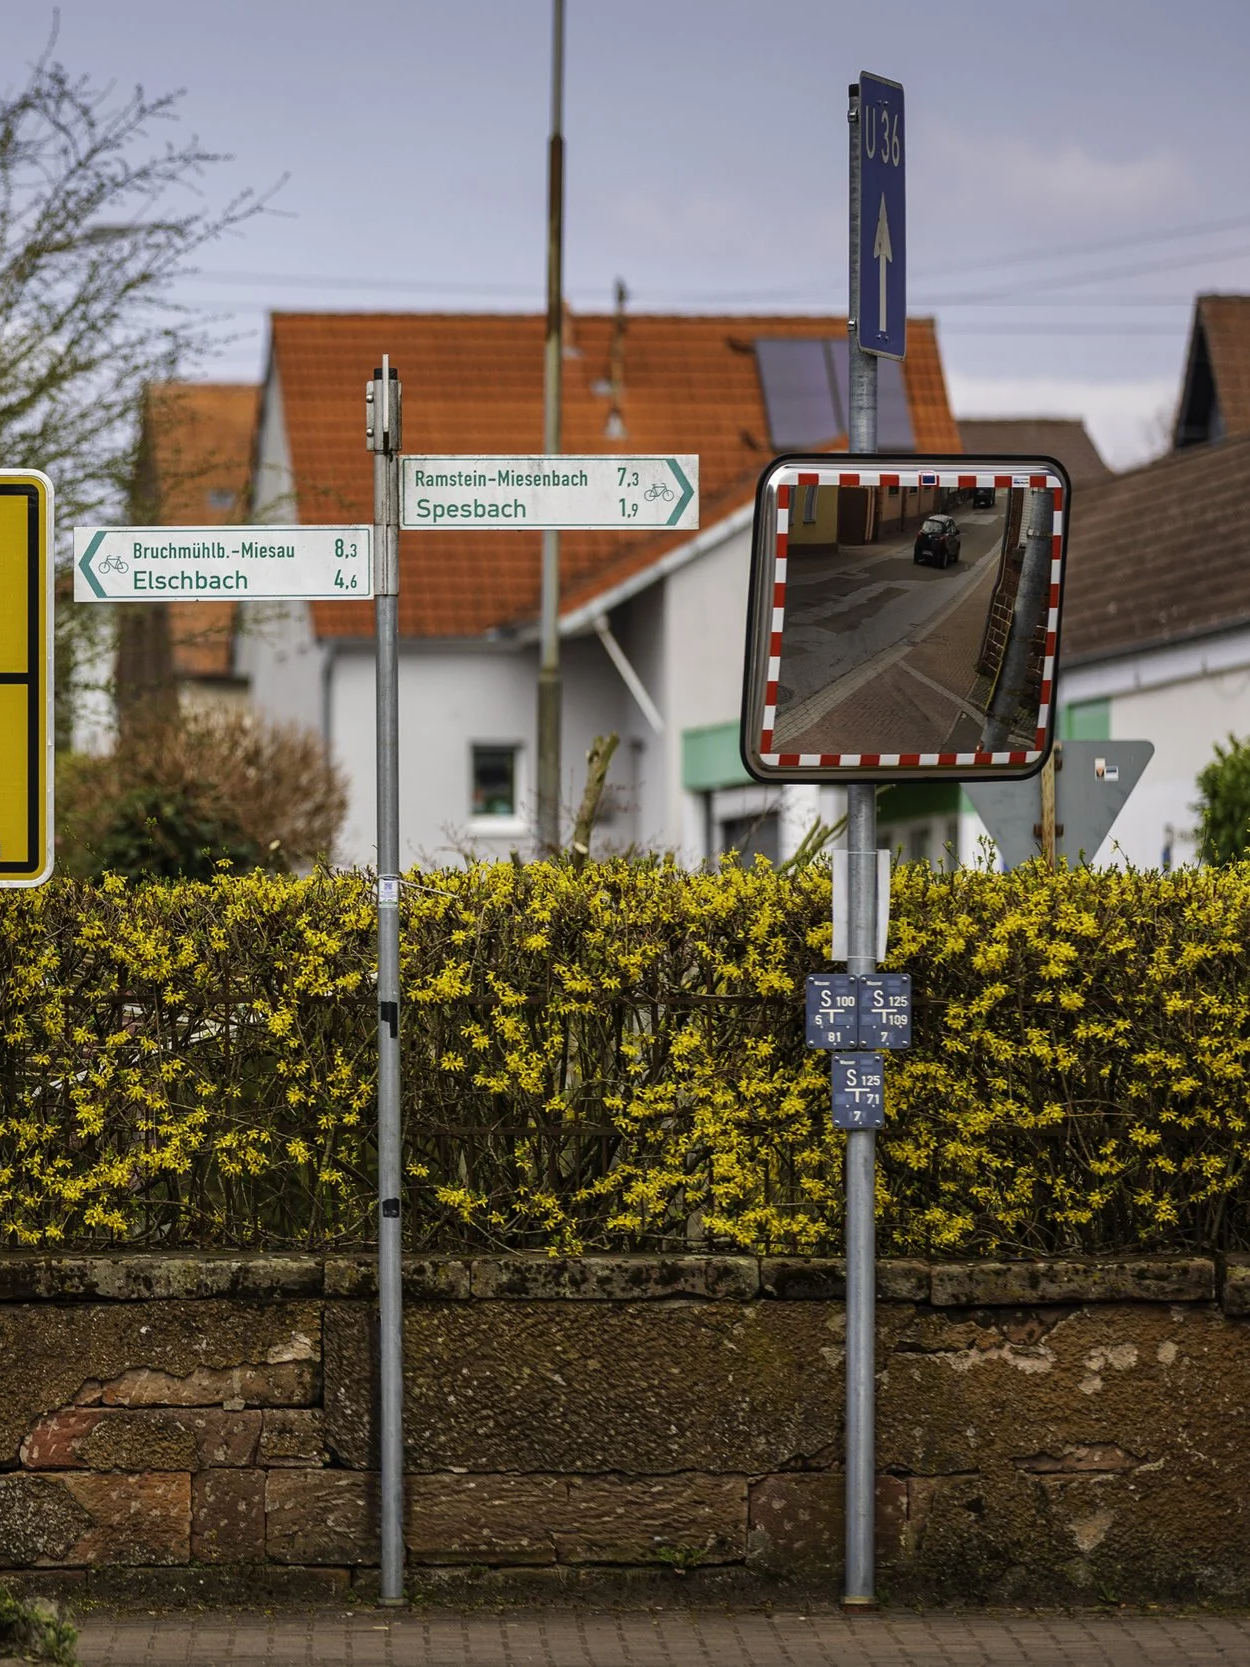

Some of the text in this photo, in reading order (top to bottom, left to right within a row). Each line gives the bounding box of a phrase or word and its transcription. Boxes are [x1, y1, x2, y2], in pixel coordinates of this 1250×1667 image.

[865, 105, 900, 167] U 36
[415, 467, 639, 488] Ramstein-Miesenbach 7,3
[416, 498, 639, 522] Spesbach 1,9
[133, 538, 358, 559] Bruchmühlb.-Miesau 8,3
[133, 569, 358, 590] Elschbach 4,6
[820, 989, 855, 1007] S 100
[873, 989, 908, 1007] S 125
[846, 1068, 881, 1086] S 125
